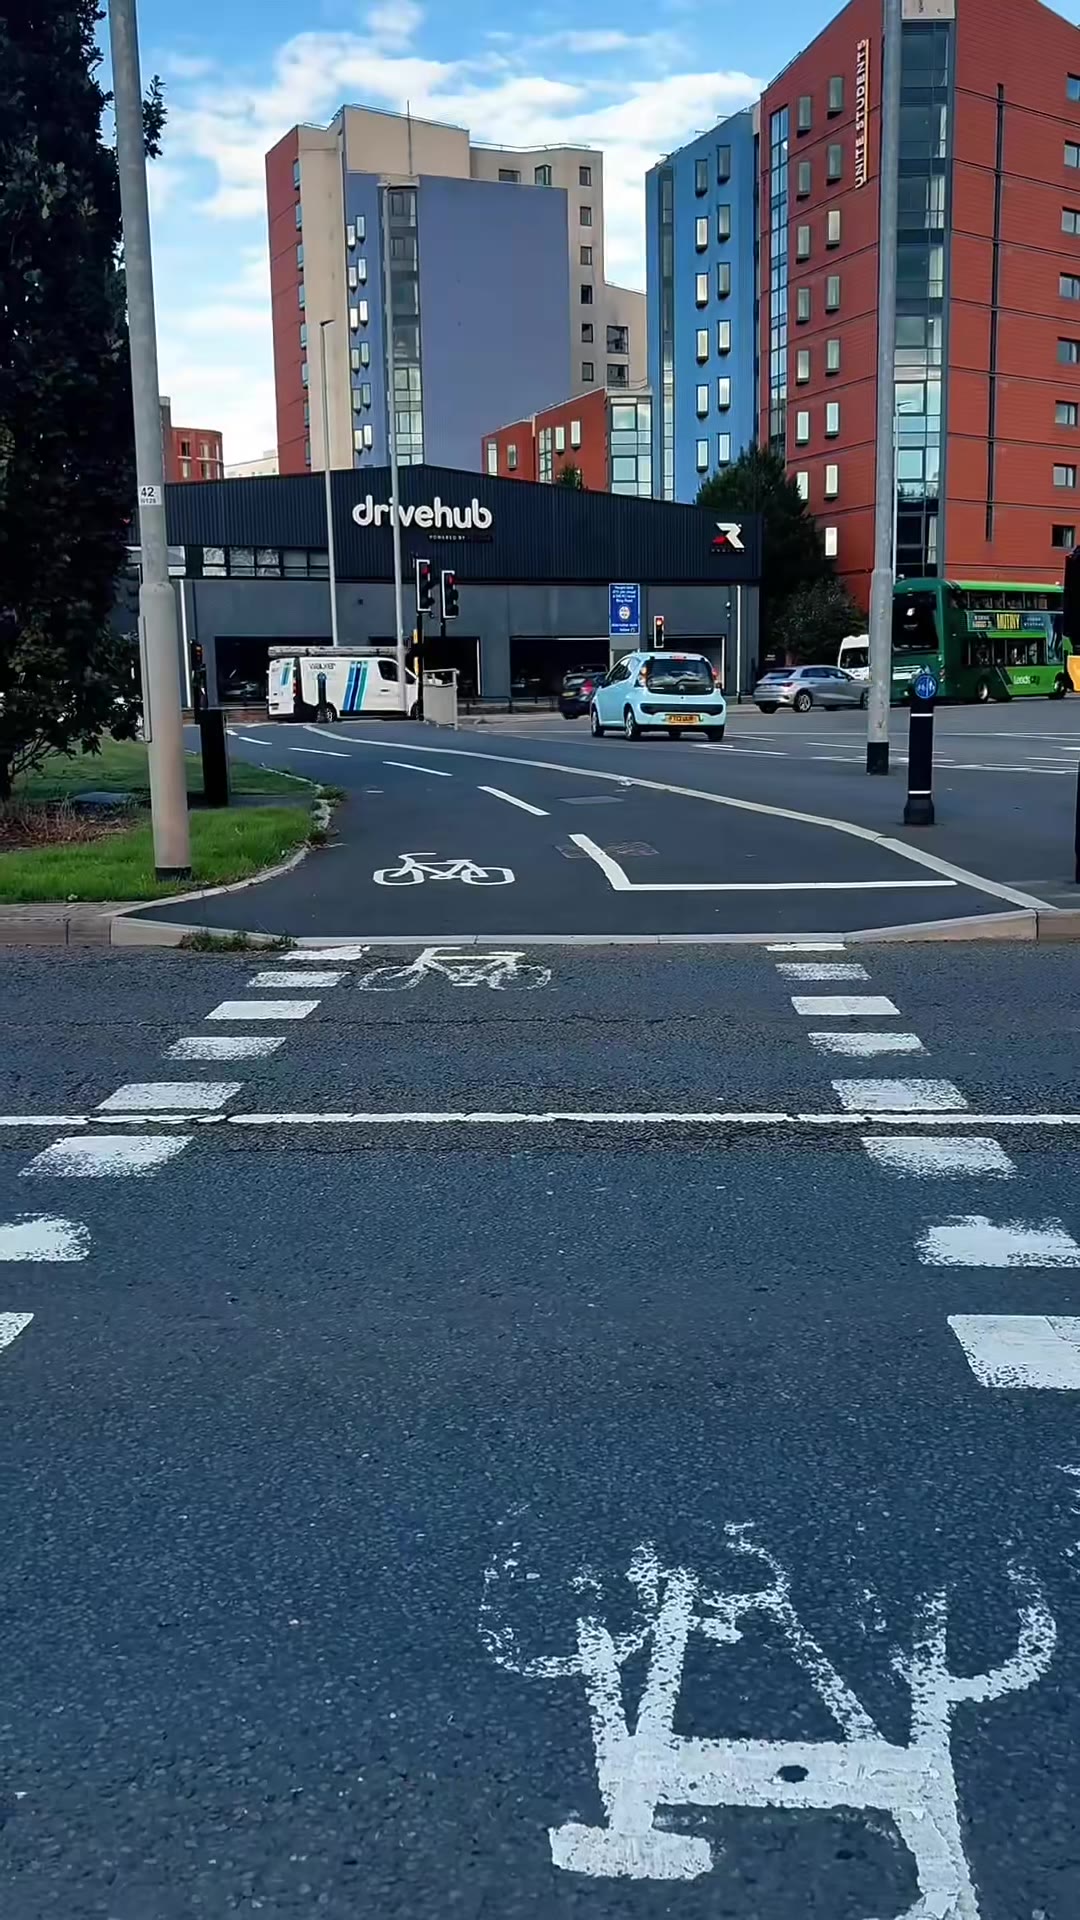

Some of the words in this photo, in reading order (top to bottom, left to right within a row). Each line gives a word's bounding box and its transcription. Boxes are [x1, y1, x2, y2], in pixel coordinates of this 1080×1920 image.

[855, 39, 867, 131] STUDENTS
[855, 134, 866, 189] UNITE
[141, 486, 155, 497] 42
[352, 494, 493, 529] drivehub
